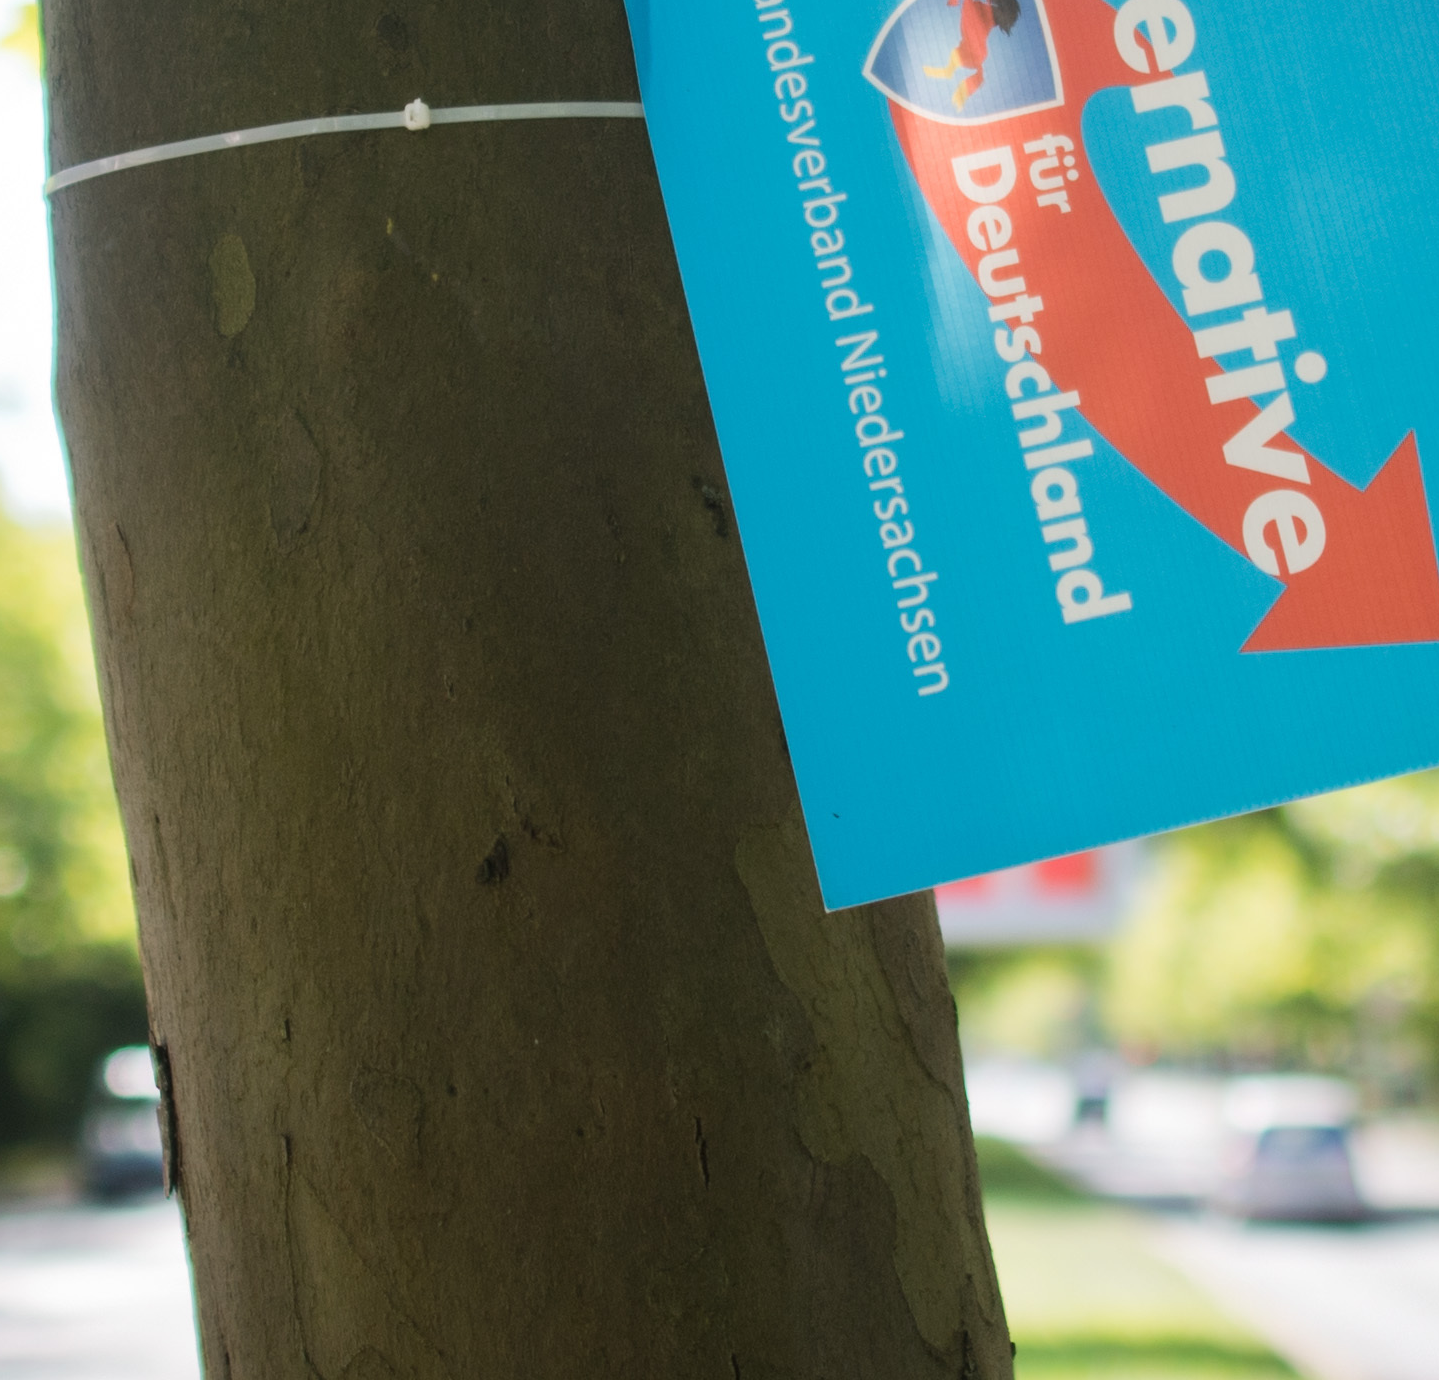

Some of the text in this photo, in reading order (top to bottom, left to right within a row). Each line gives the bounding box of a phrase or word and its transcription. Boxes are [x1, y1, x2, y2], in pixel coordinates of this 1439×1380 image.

[1023, 133, 1079, 214] für
[834, 329, 950, 697] Niedersachsen
[951, 144, 1133, 625] Deutschland
